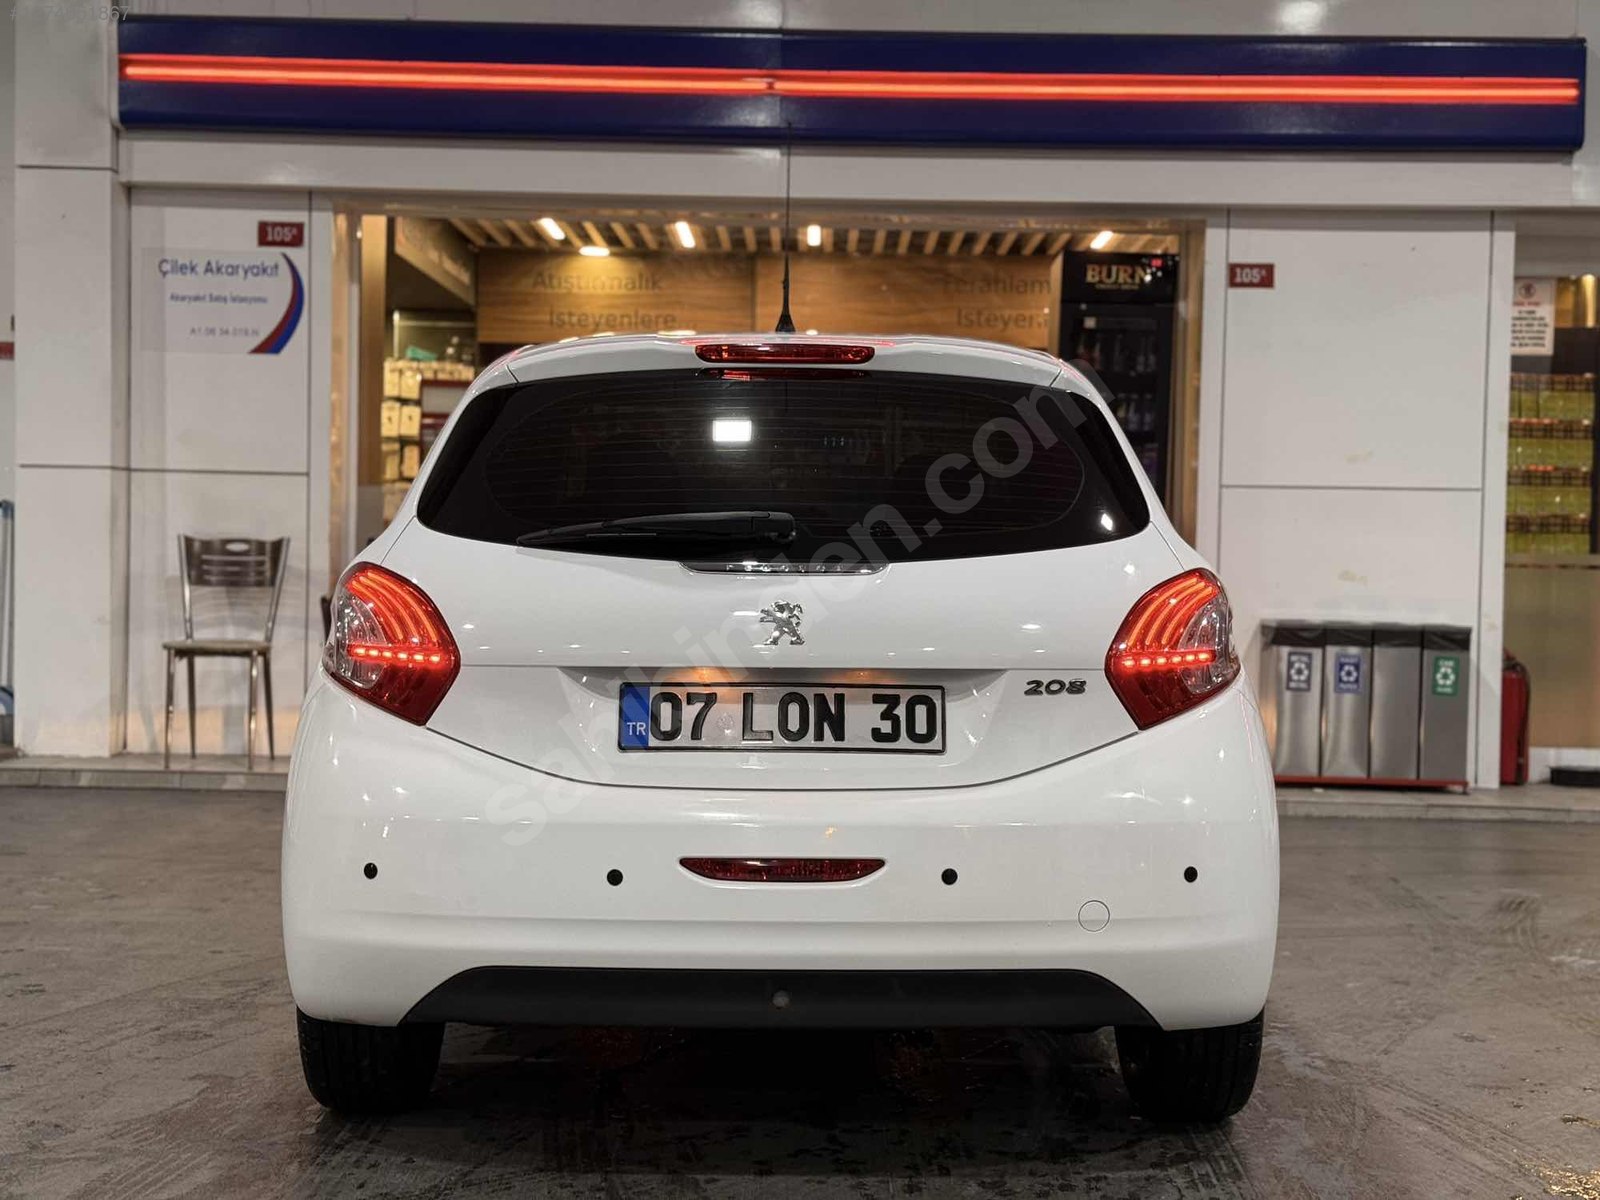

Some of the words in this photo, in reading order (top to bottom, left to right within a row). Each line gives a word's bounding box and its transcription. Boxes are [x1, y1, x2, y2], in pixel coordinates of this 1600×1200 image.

[158, 258, 199, 278] Çilek
[203, 259, 279, 280] Akaryakıt
[1087, 264, 1150, 284] BURN
[1024, 679, 1087, 696] 208
[626, 721, 647, 736] TR
[650, 691, 718, 741] 07
[742, 691, 846, 742] LON
[871, 694, 938, 744] 30
